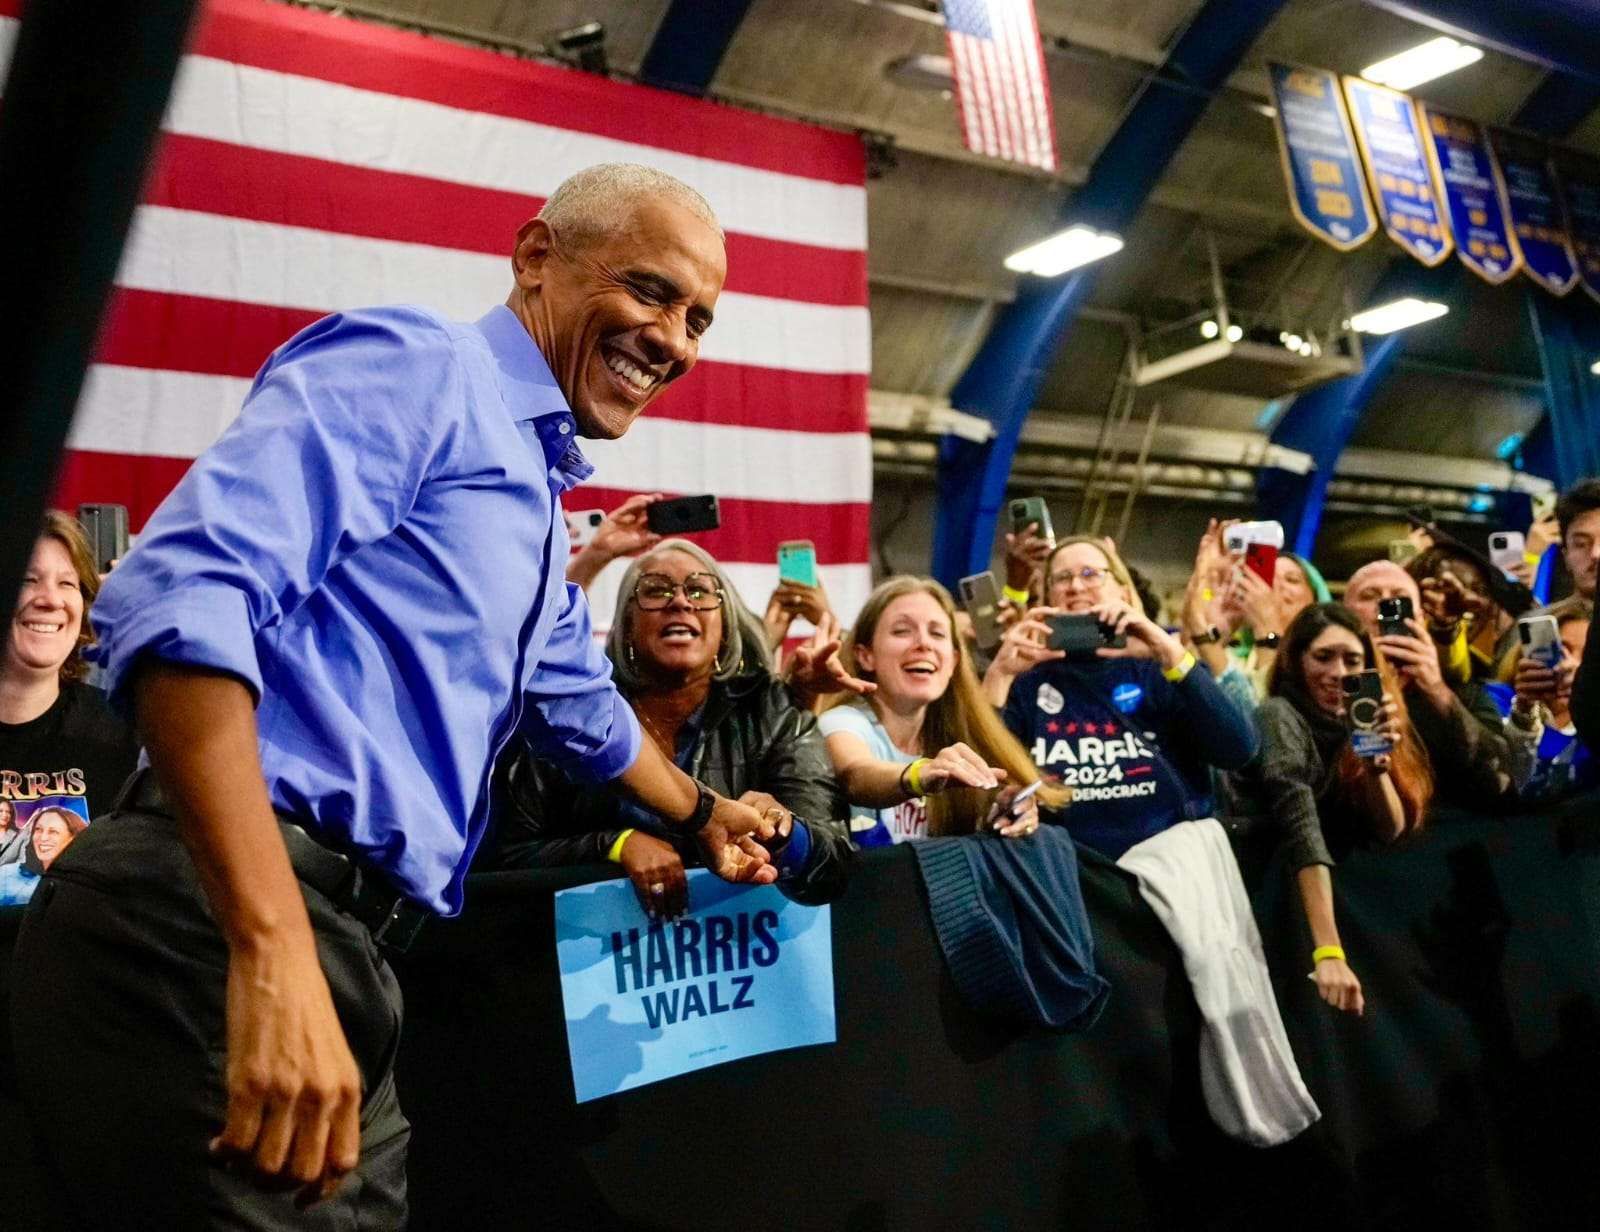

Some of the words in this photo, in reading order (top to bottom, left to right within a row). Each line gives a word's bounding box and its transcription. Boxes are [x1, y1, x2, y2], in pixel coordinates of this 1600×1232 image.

[1064, 764, 1124, 785] 2024
[1072, 781, 1156, 801] DEMOCRACY
[612, 909, 779, 994] HARRIS
[641, 974, 754, 1029] WALZ
